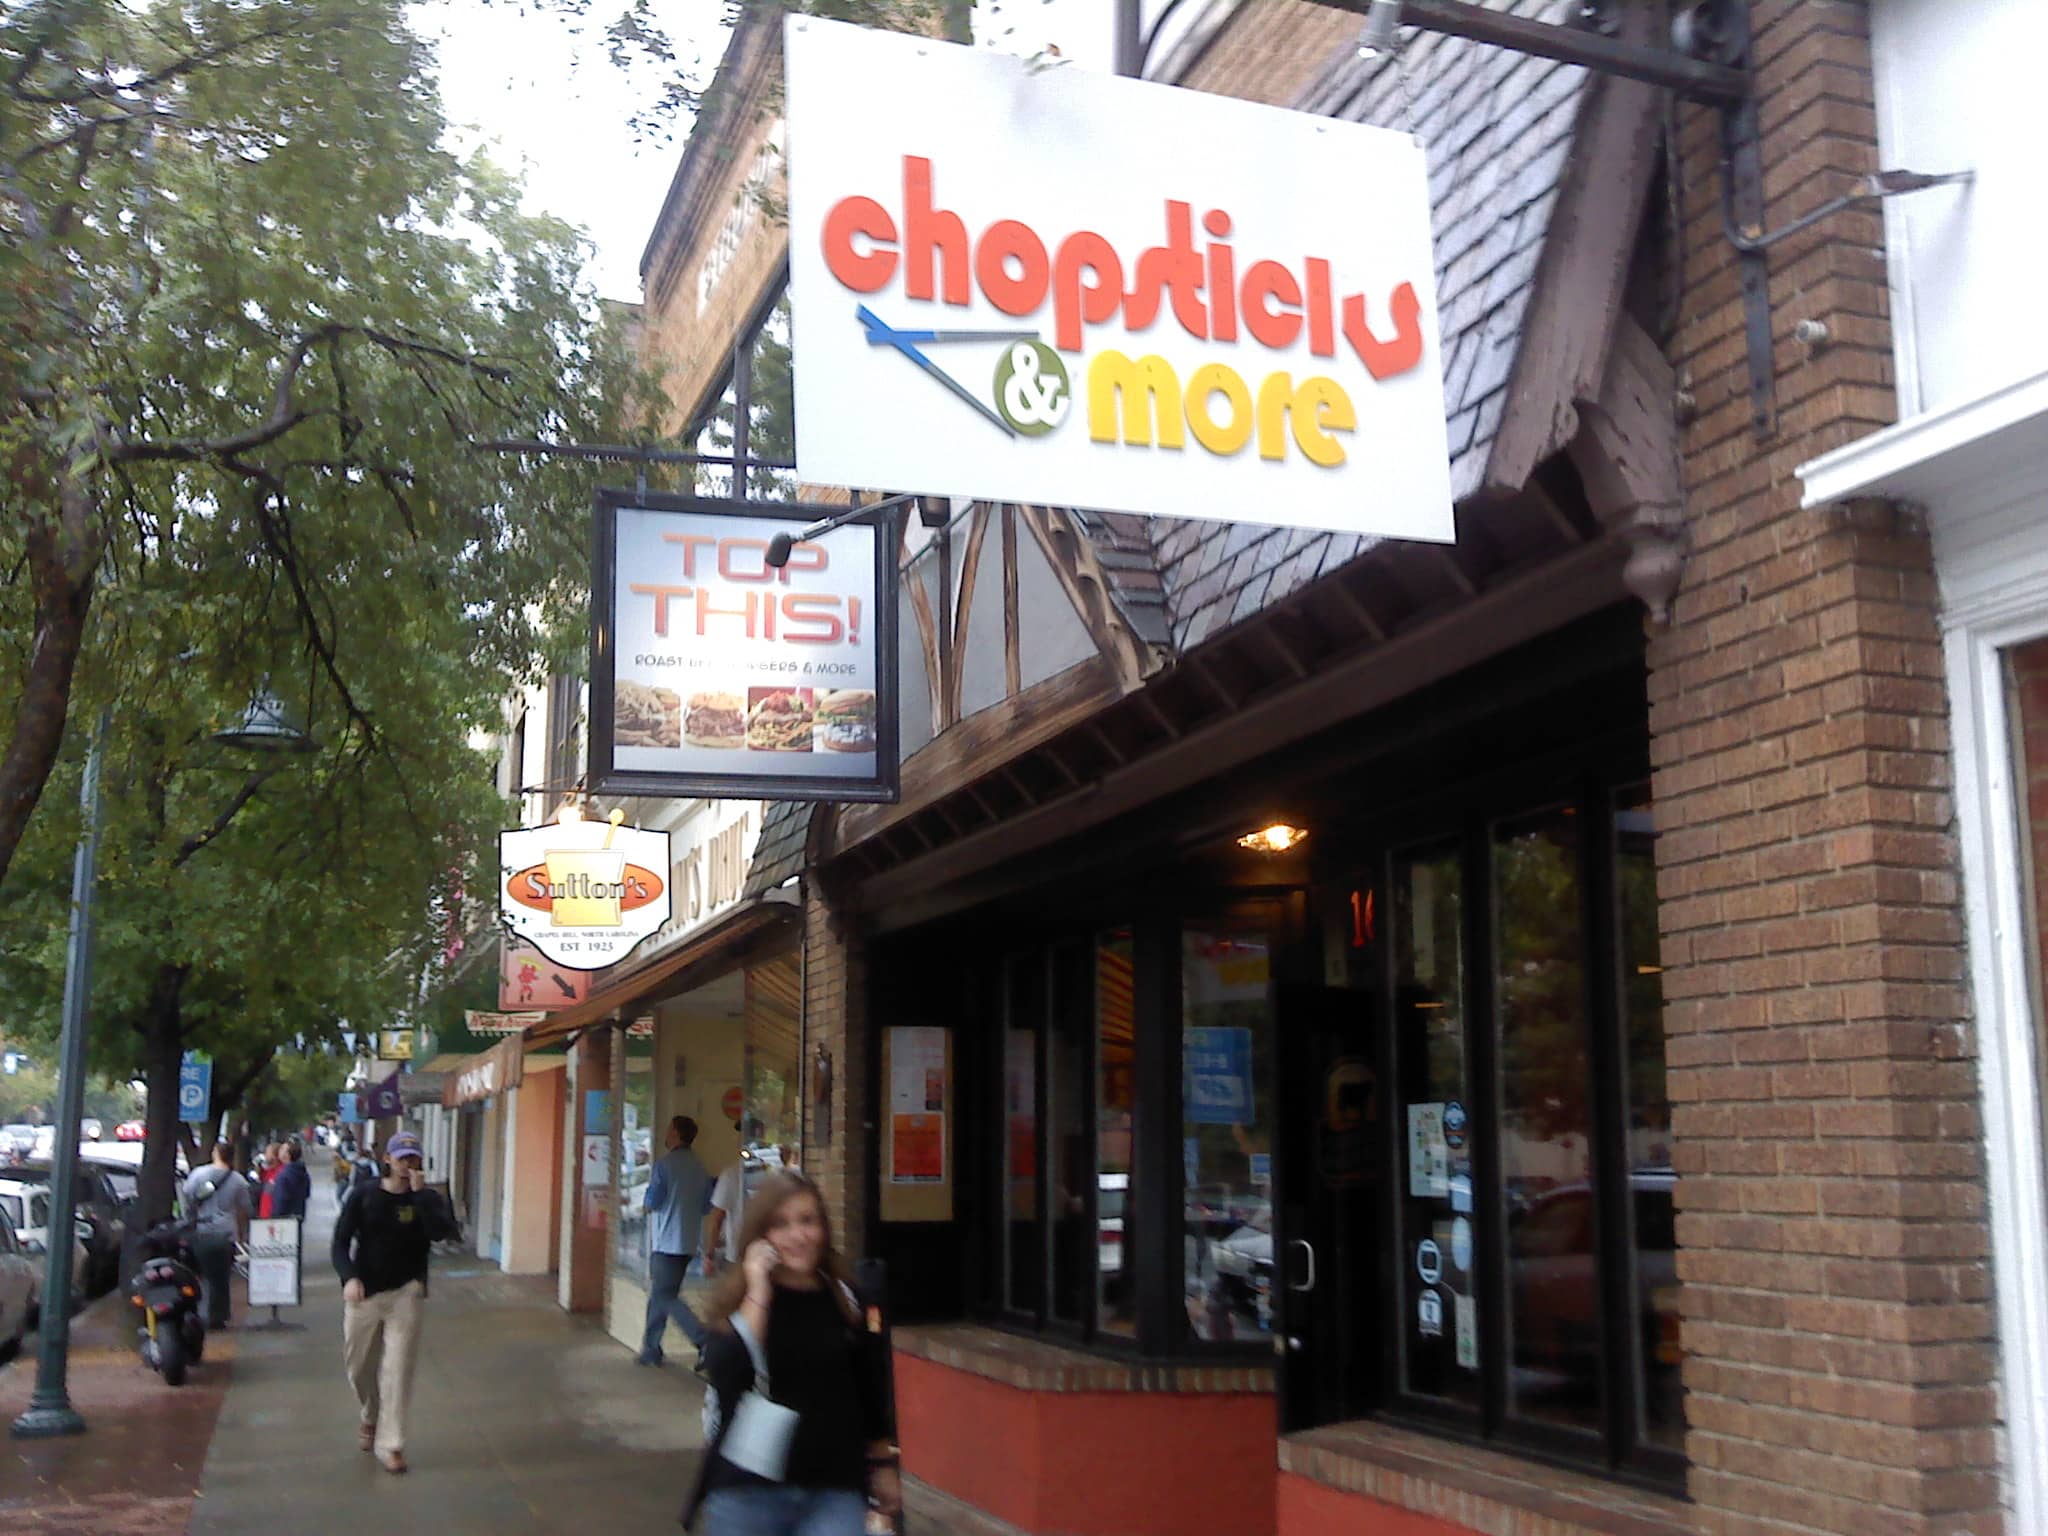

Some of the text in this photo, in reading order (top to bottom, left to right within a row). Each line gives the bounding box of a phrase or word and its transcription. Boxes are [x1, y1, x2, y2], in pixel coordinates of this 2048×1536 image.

[1000, 343, 1358, 468] & more
[662, 532, 829, 584] TOP
[629, 582, 862, 646] THIS!
[634, 653, 683, 668] ROAST
[802, 662, 813, 675] &
[816, 661, 857, 676] MORE
[524, 871, 649, 900] Sutton's
[560, 942, 581, 952] EST
